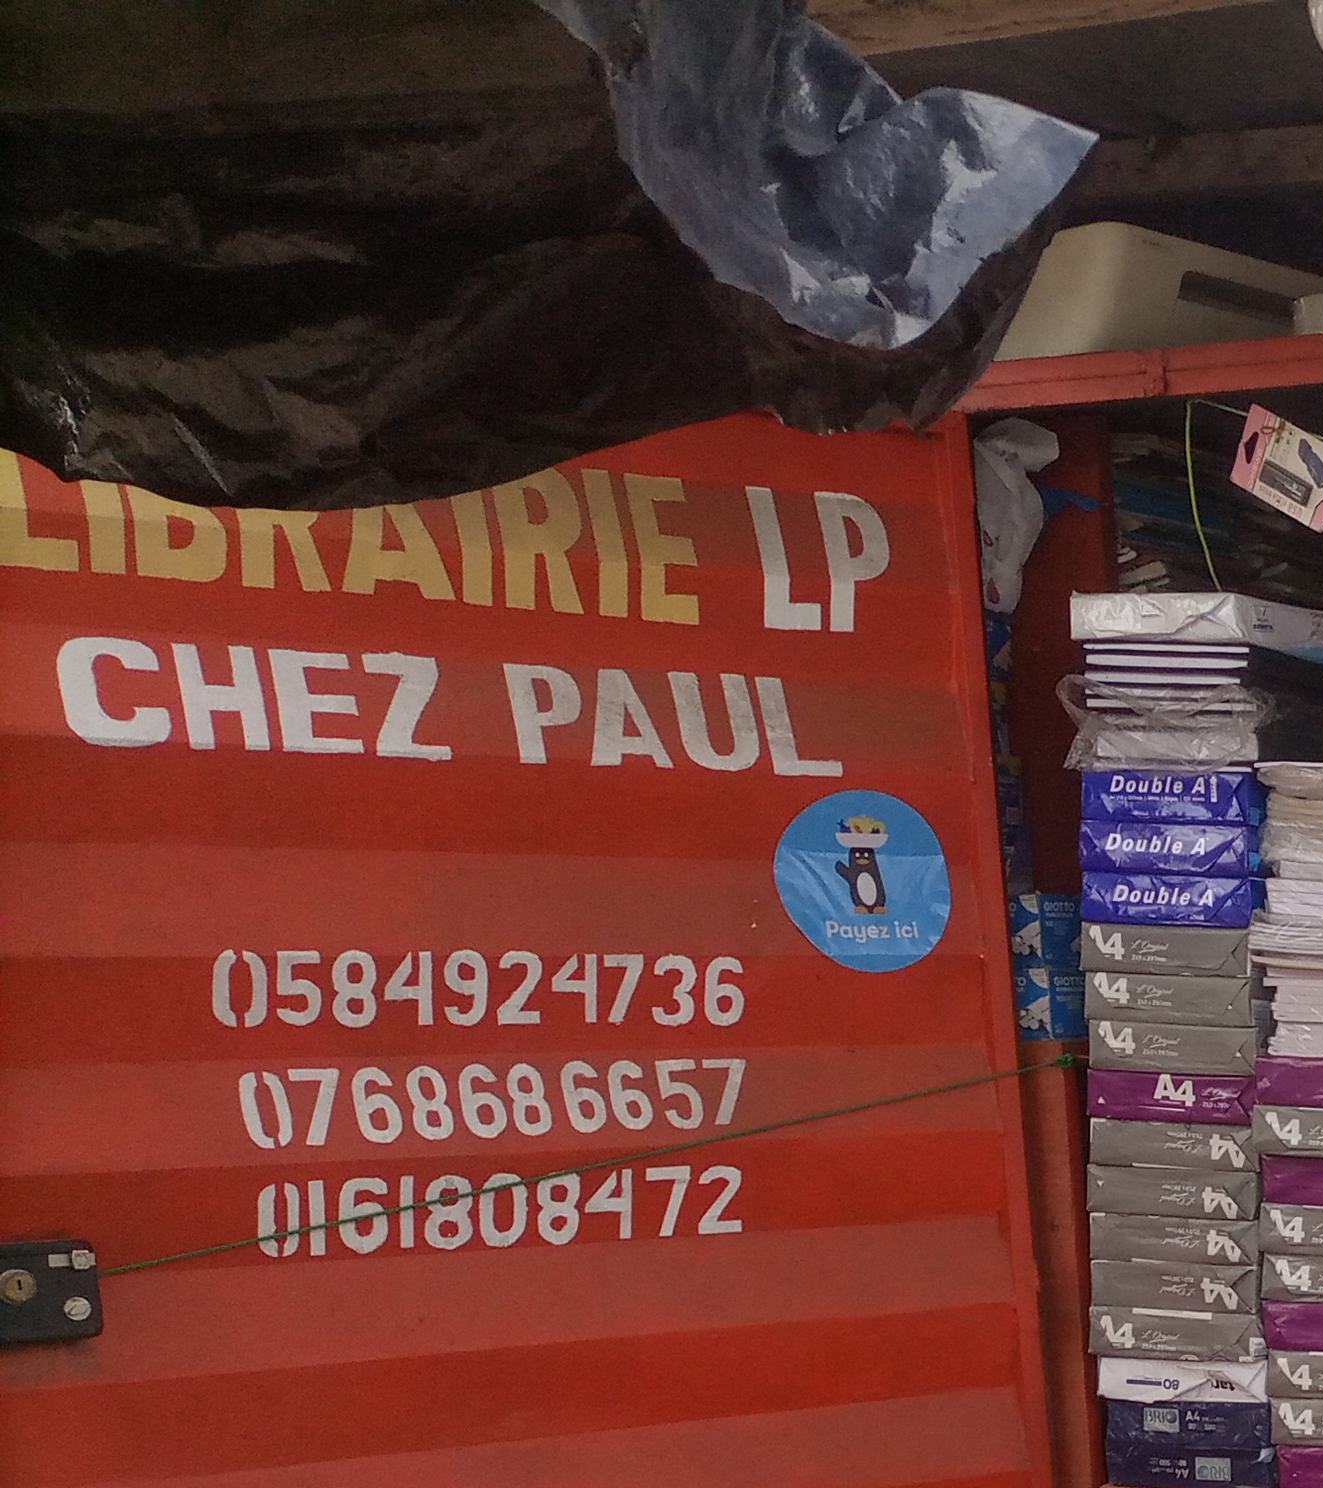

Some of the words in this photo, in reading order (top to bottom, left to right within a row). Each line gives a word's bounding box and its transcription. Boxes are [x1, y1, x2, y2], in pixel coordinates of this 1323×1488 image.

[0, 447, 699, 625] LIBRAIRIE
[745, 484, 890, 633] LP
[56, 636, 452, 761] CHEZ
[503, 663, 843, 778] PAUL
[1110, 776, 1185, 794] Double
[1191, 776, 1206, 794] A
[1105, 833, 1182, 853] Double
[1190, 837, 1206, 855] A
[1044, 901, 1076, 912] GIOTTO
[1113, 884, 1190, 906] Double
[1197, 889, 1214, 907] A
[824, 918, 891, 945] Payez
[896, 917, 920, 941] ici
[211, 950, 746, 1029] 0584924736
[239, 1058, 746, 1149] 0768686657
[1154, 1074, 1196, 1106] A4
[257, 1165, 743, 1258] 0161808472
